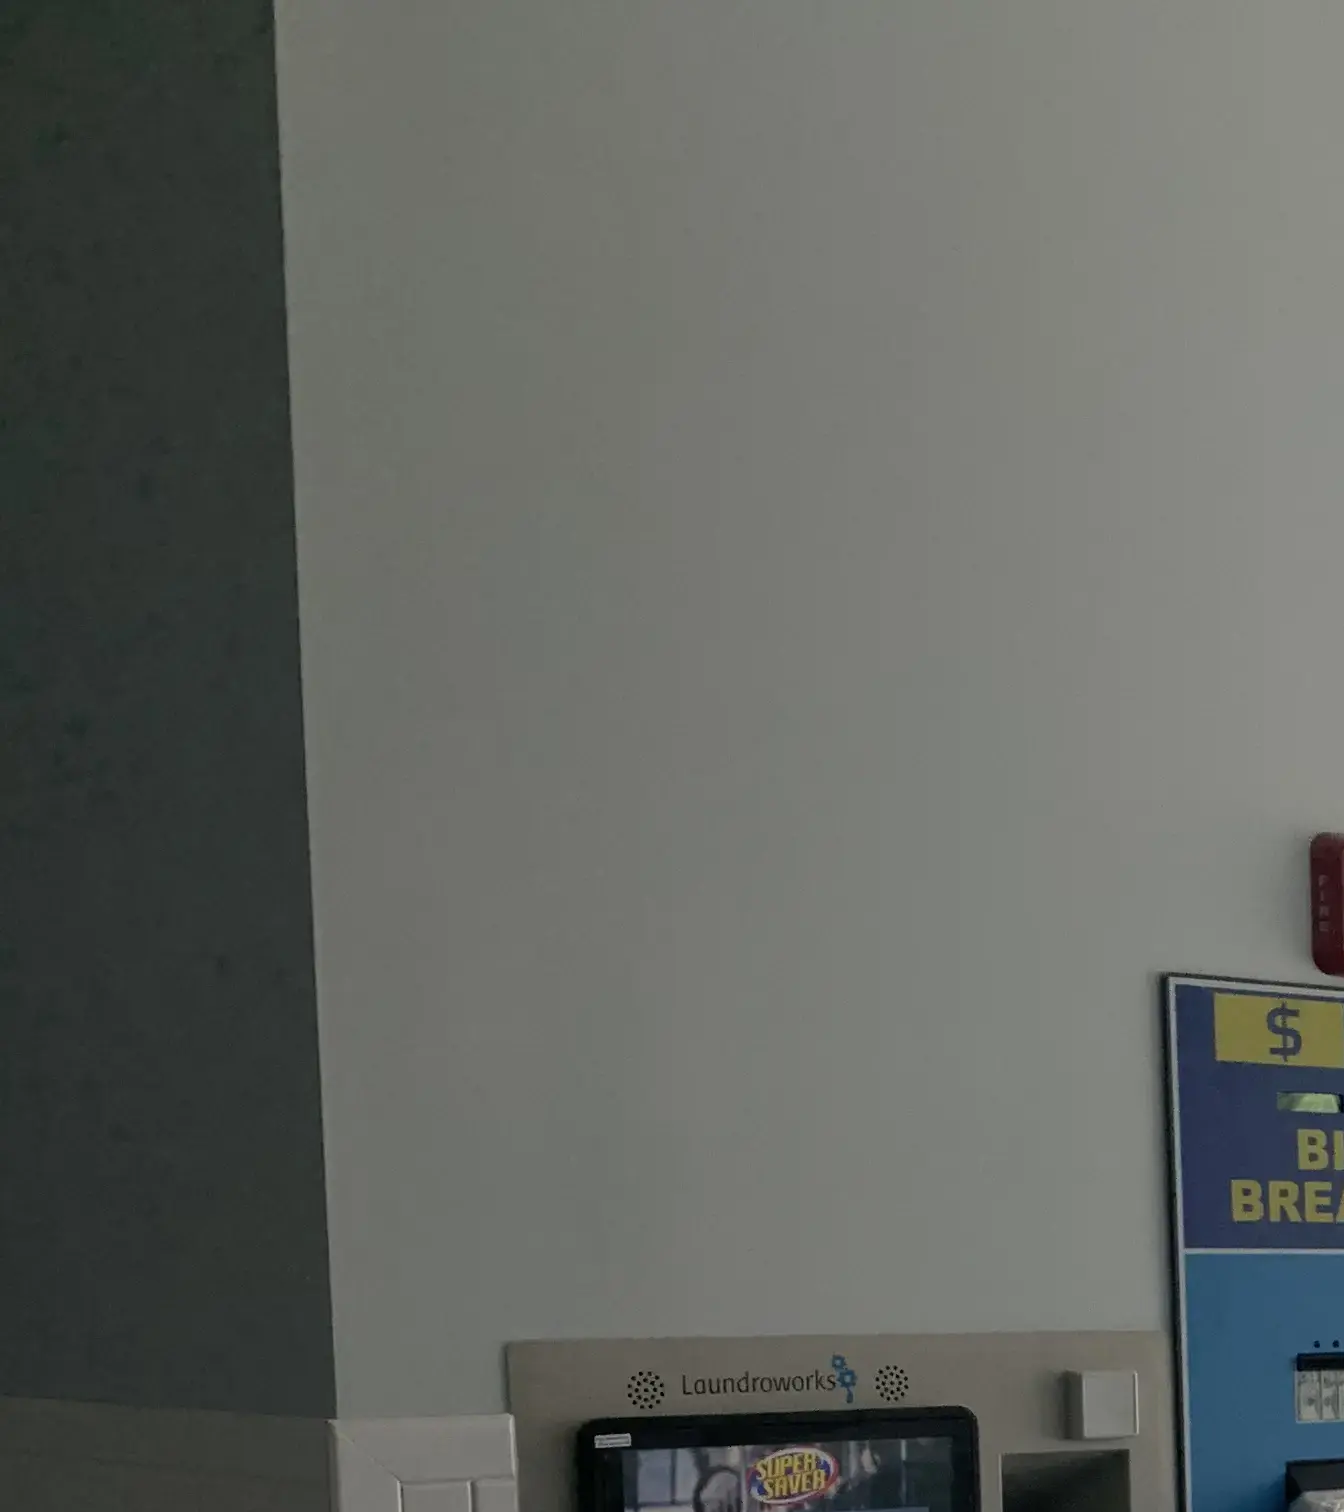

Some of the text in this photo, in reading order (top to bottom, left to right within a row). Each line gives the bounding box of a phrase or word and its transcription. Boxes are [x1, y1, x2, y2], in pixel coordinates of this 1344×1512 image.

[681, 1369, 837, 1396] Laundroworks
[755, 1451, 818, 1480] SUPER
[764, 1469, 827, 1498] SAVER
